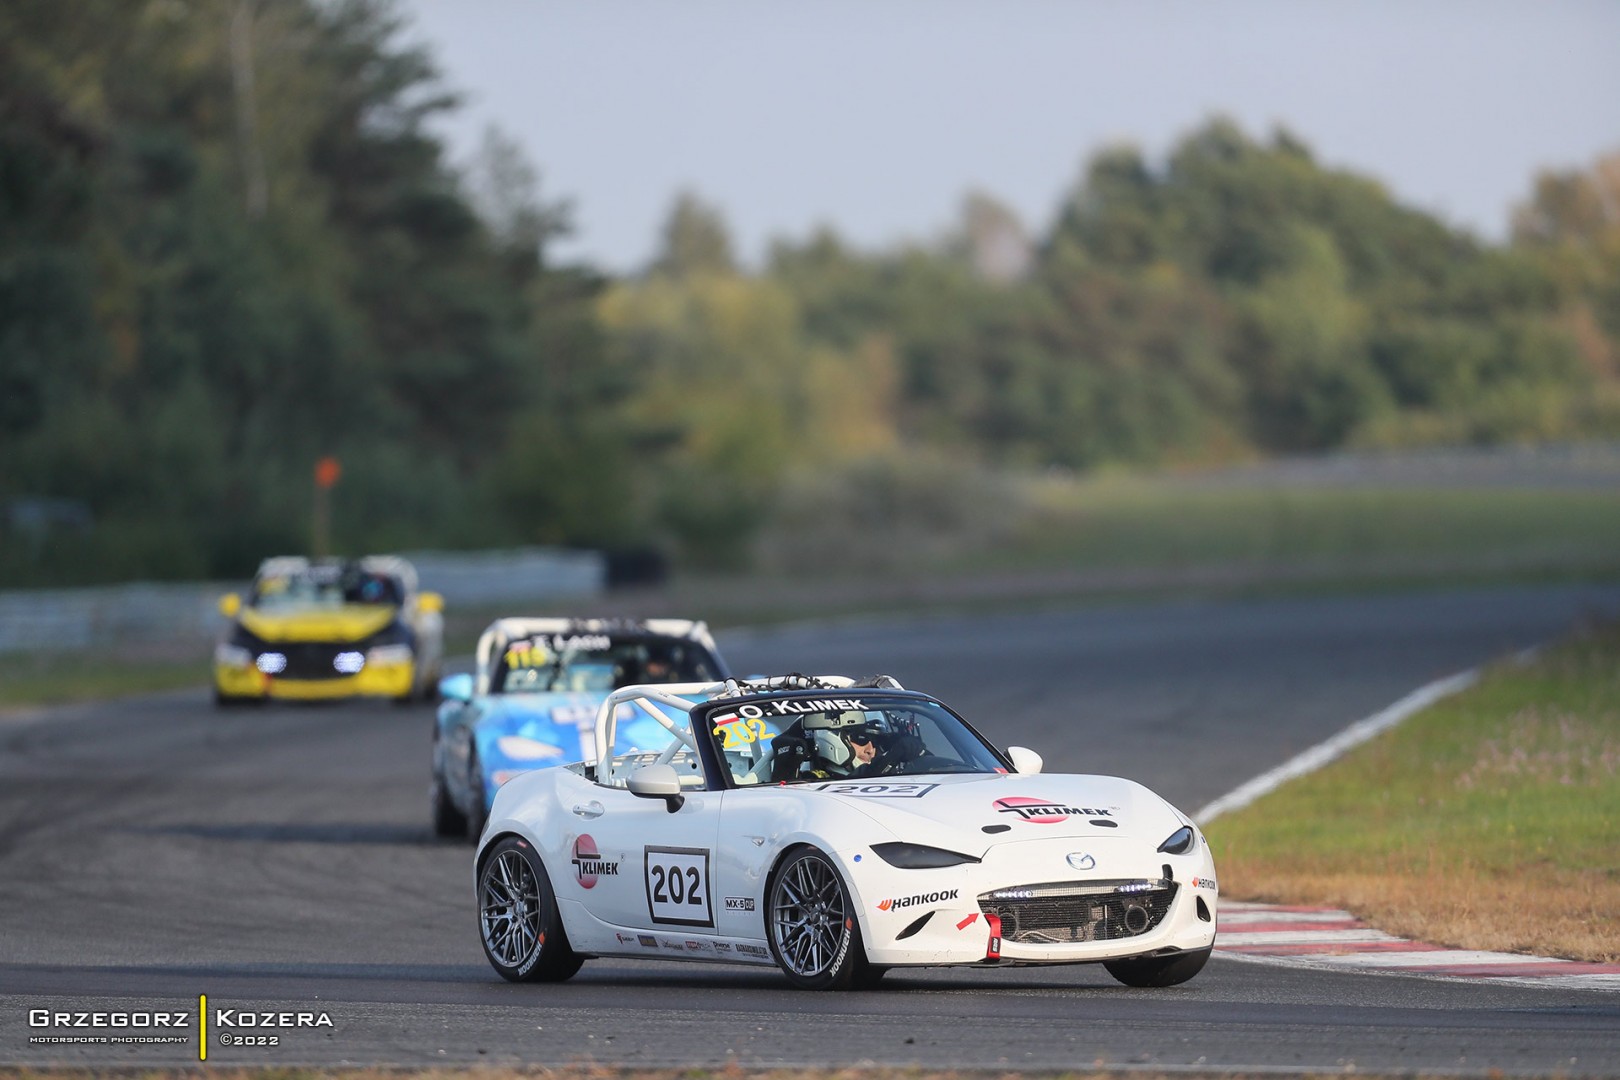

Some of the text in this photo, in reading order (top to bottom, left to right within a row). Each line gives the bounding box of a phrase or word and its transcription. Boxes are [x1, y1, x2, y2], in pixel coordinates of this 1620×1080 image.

[739, 700, 869, 719] O. KLIMEK
[713, 718, 776, 749] 202
[830, 785, 919, 794] 202
[1026, 807, 1113, 816] KLIMEK
[582, 861, 619, 876] KLIMEK
[651, 864, 702, 905] 202
[726, 899, 745, 909] MX-5
